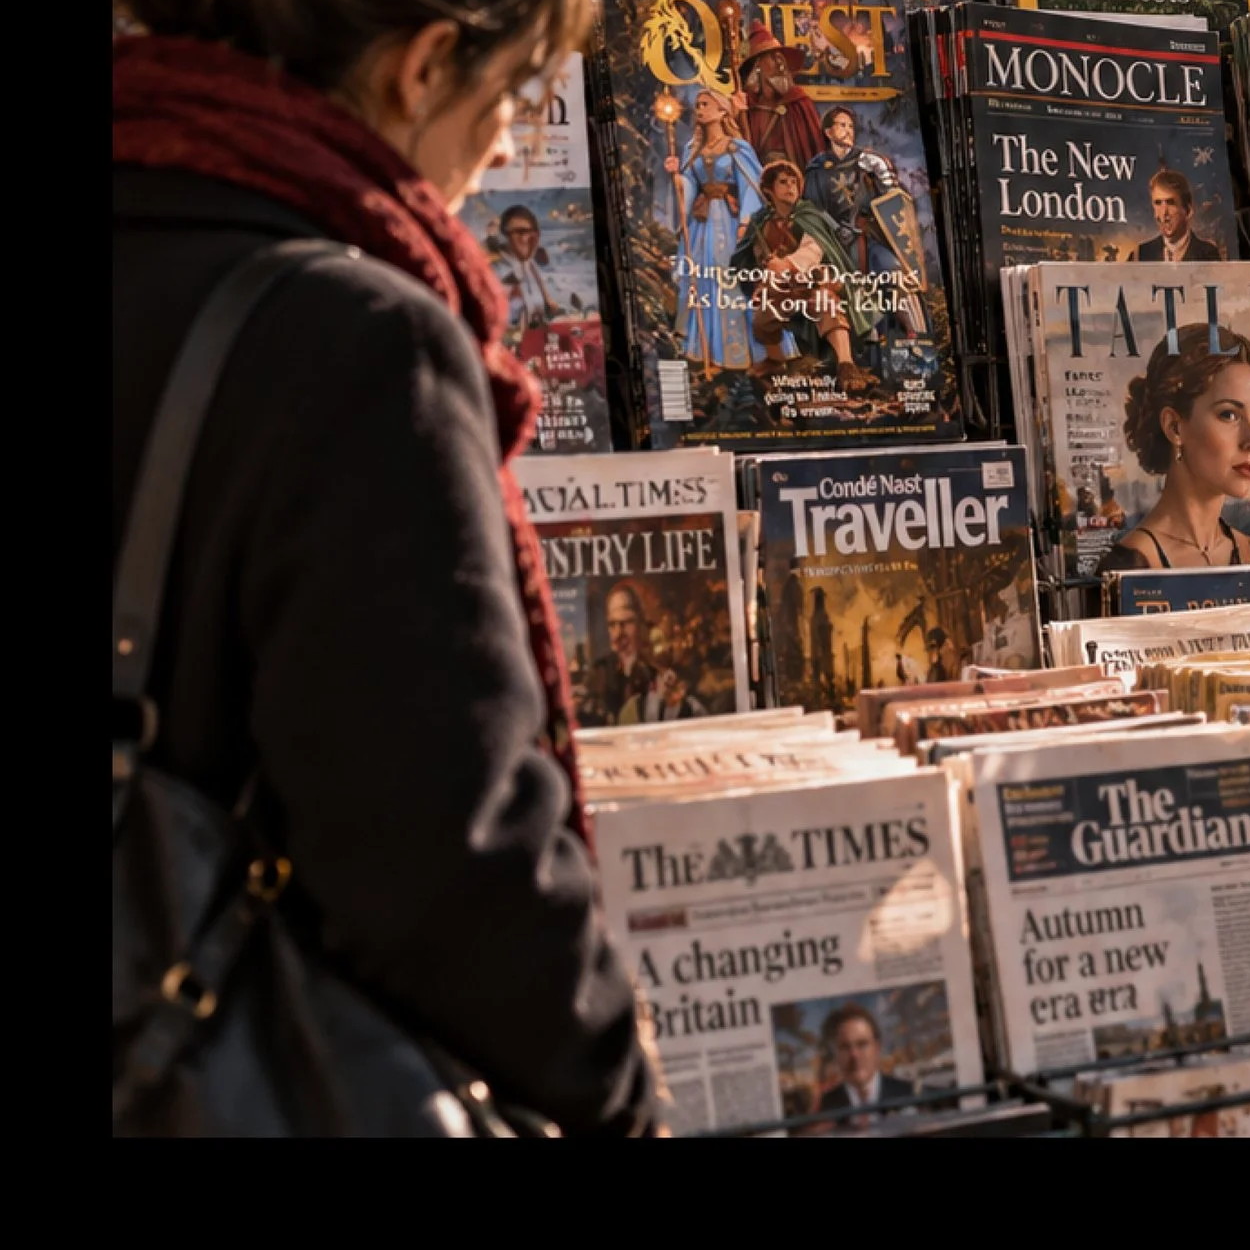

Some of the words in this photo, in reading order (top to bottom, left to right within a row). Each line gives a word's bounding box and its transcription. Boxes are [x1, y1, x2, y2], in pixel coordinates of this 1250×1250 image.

[983, 43, 1207, 106] MONOCLE
[992, 133, 1058, 177] The
[1066, 141, 1136, 181] New
[997, 178, 1127, 223] London
[671, 255, 791, 292] Dungeons
[811, 264, 919, 294] Dragons
[688, 286, 710, 309] is
[717, 289, 790, 322] back
[782, 299, 820, 322] on
[819, 474, 877, 499] Condé
[880, 473, 922, 495] Nast
[780, 477, 1008, 557] Traveller
[642, 528, 717, 573] LIFE
[1099, 778, 1175, 827] The
[791, 816, 929, 871] TIMES
[1020, 903, 1146, 945] Autumn
[637, 946, 662, 988] A
[672, 930, 843, 984] changing
[1023, 948, 1069, 986] for
[1079, 954, 1098, 978] a
[1105, 940, 1170, 975] new
[1030, 996, 1082, 1024] era
